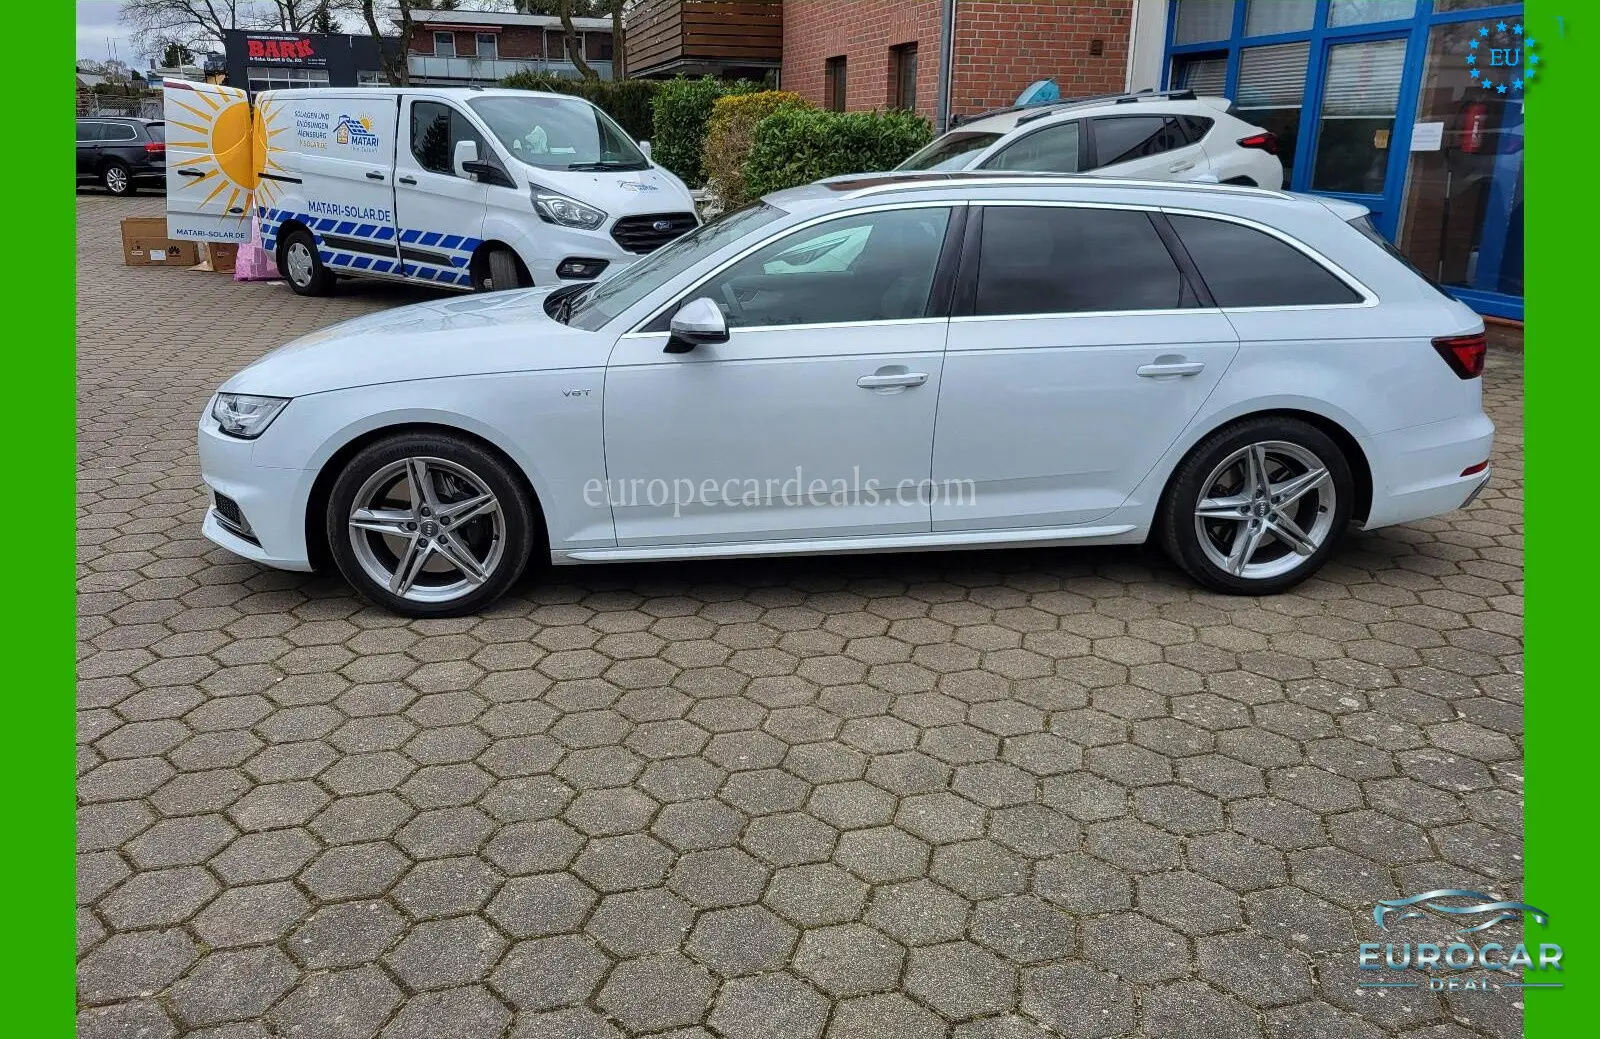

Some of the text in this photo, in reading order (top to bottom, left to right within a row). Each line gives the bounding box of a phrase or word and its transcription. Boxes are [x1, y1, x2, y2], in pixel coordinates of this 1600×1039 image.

[247, 39, 315, 58] BARK
[351, 136, 379, 147] MATARI
[308, 200, 391, 222] MATARI-SOLAR.DE
